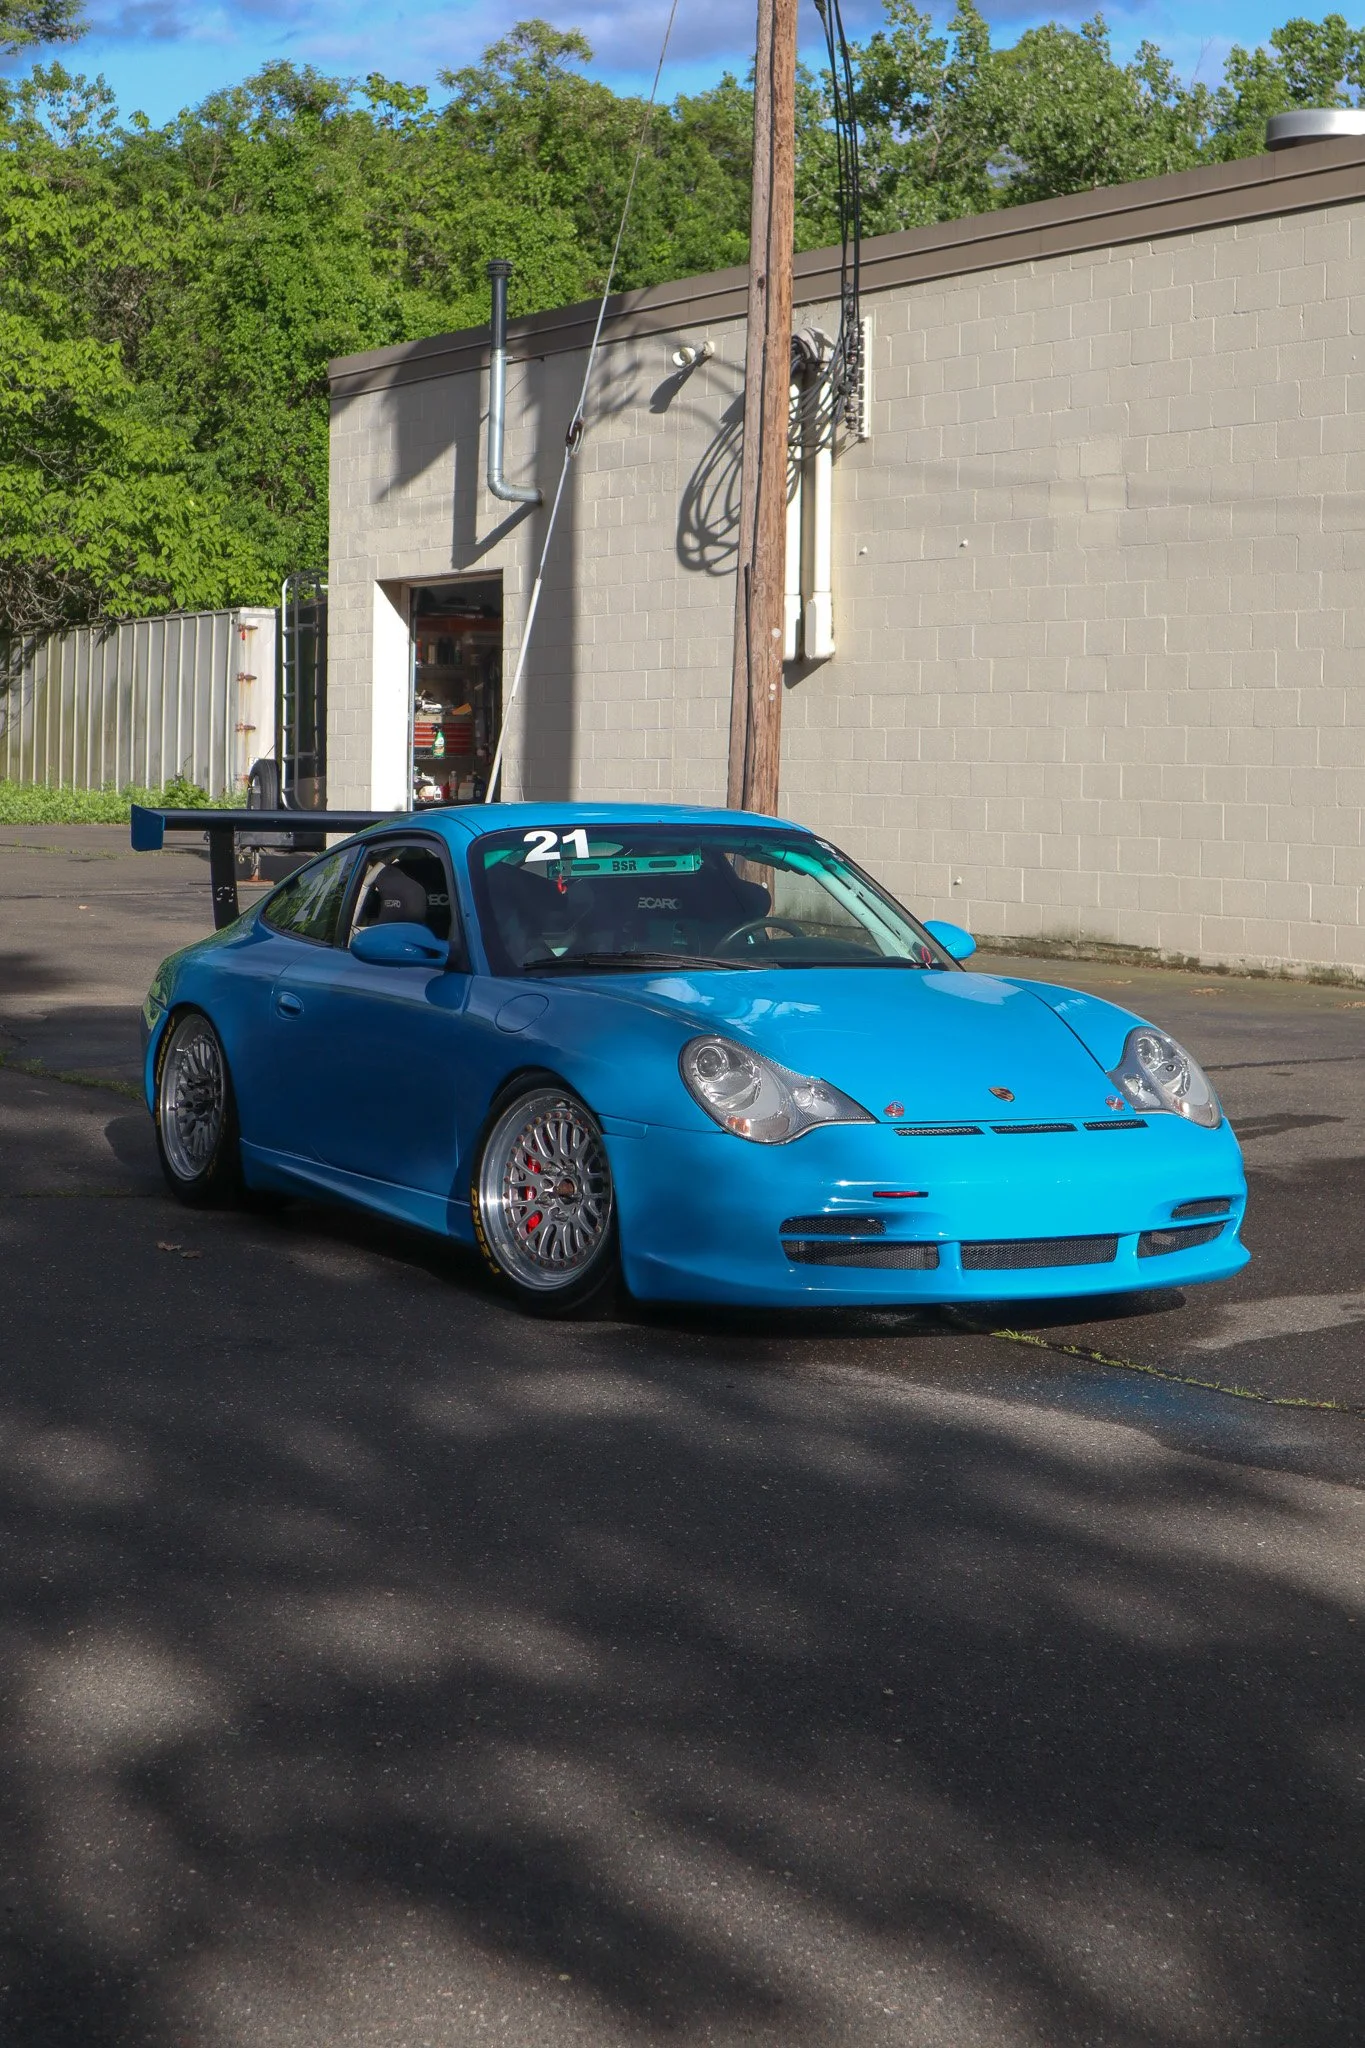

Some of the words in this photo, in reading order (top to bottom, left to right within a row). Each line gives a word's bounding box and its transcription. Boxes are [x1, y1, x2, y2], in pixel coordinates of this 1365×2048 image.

[523, 829, 590, 863] 21
[612, 860, 637, 872] BSR
[292, 874, 336, 923] 21
